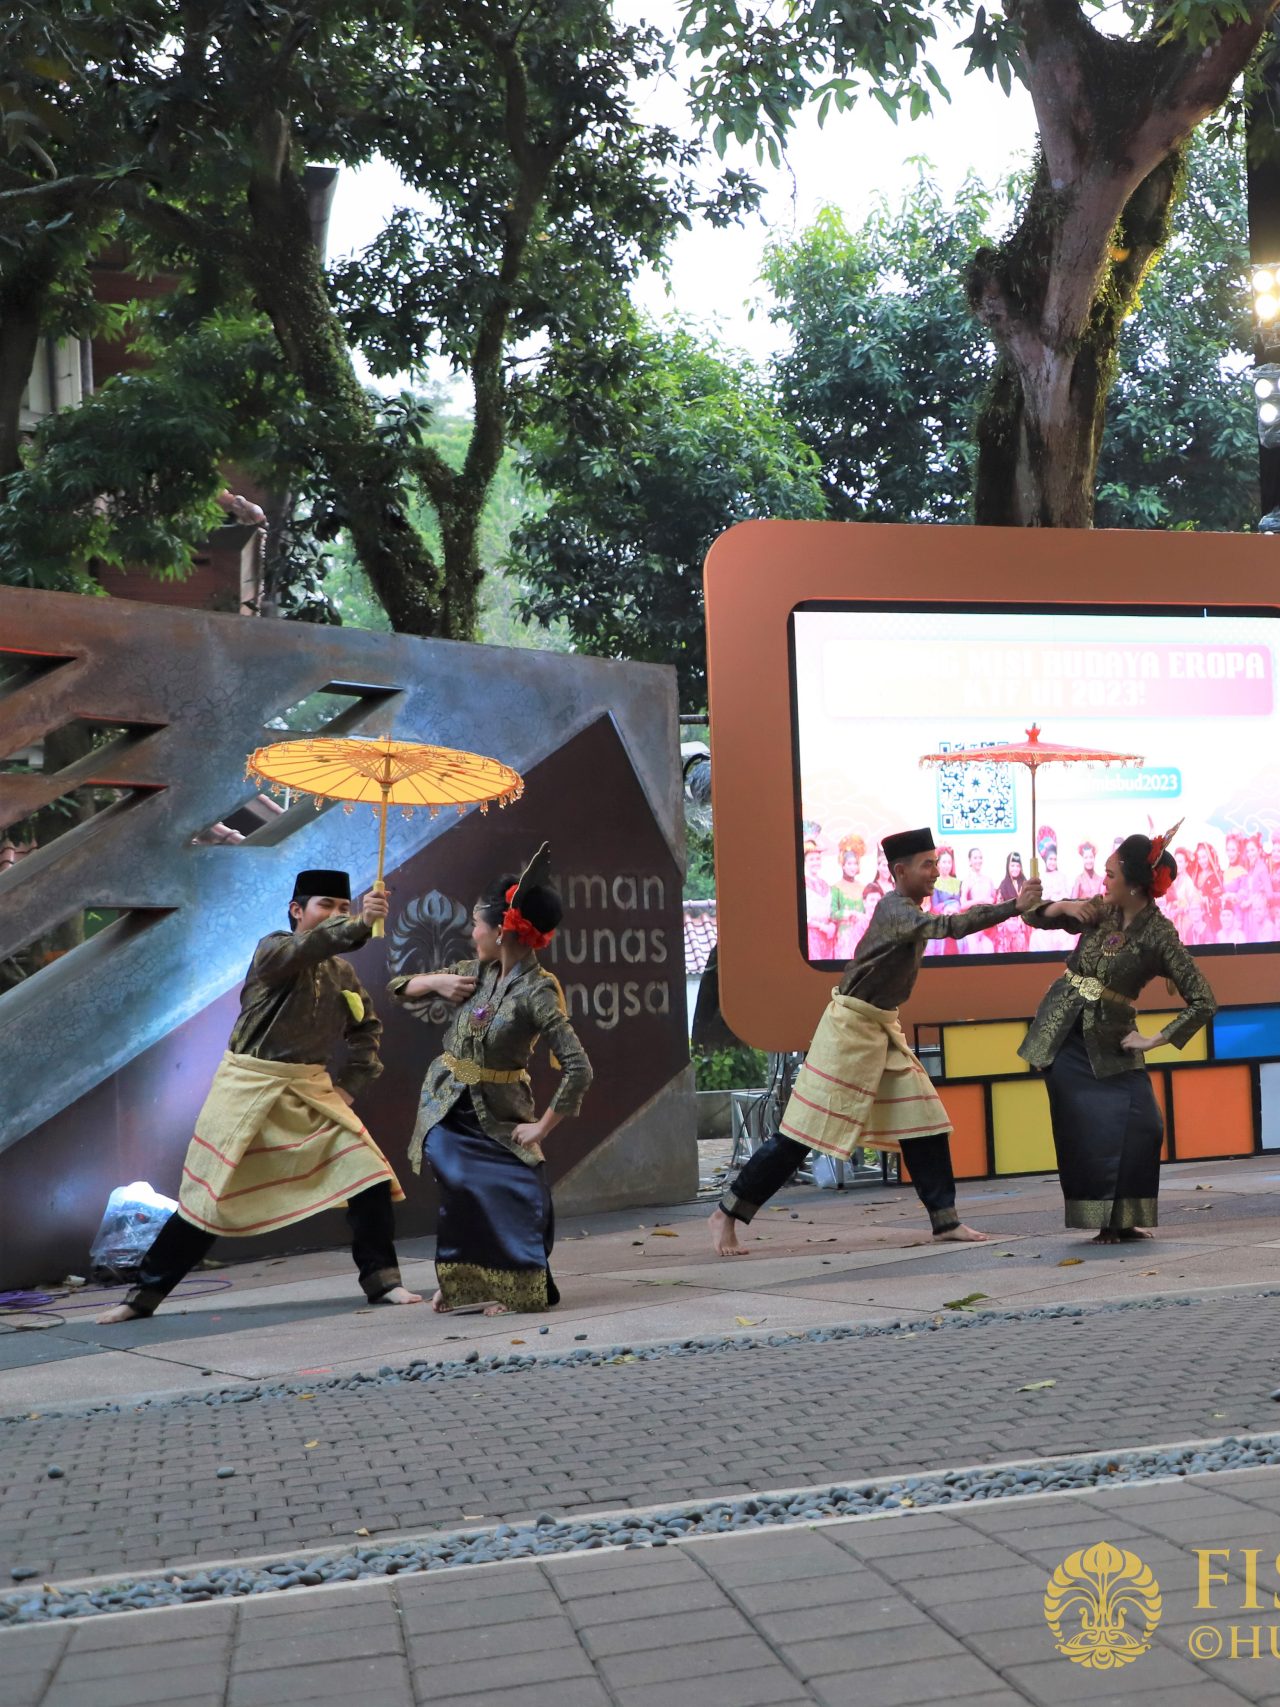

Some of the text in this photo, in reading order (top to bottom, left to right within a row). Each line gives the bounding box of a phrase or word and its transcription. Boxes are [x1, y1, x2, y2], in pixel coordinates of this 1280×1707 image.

[1042, 651, 1160, 680] BUDAYA
[1168, 651, 1265, 680] EROPA
[1071, 680, 1146, 706] 2023!
[565, 981, 670, 1030] ngsa
